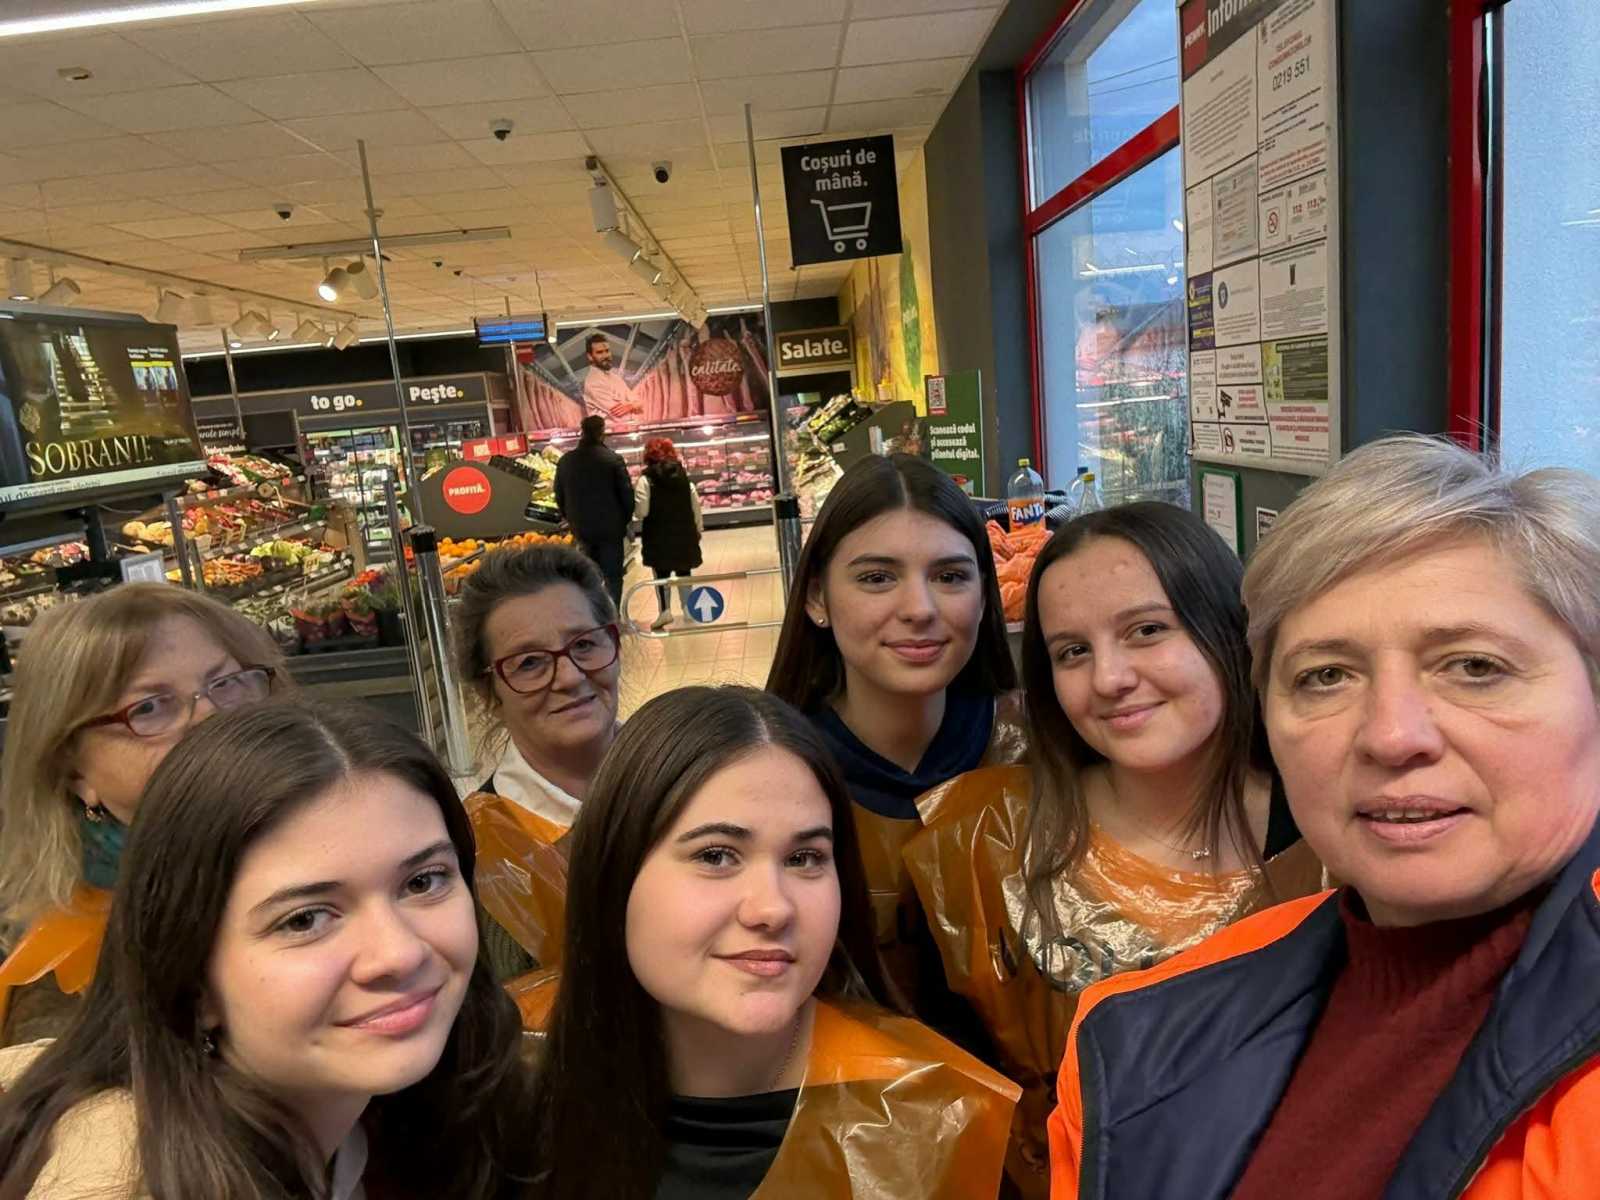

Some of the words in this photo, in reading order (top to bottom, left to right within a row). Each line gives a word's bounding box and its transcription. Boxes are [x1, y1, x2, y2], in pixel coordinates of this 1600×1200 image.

[1272, 66, 1292, 91] 0219
[1294, 55, 1310, 78] 551
[800, 149, 852, 174] Coșuri
[855, 148, 877, 165] de
[815, 170, 868, 192] mână.
[781, 338, 849, 360] Salate.
[311, 395, 330, 410] to
[333, 394, 363, 411] go.
[25, 434, 153, 476] SOBRANIE
